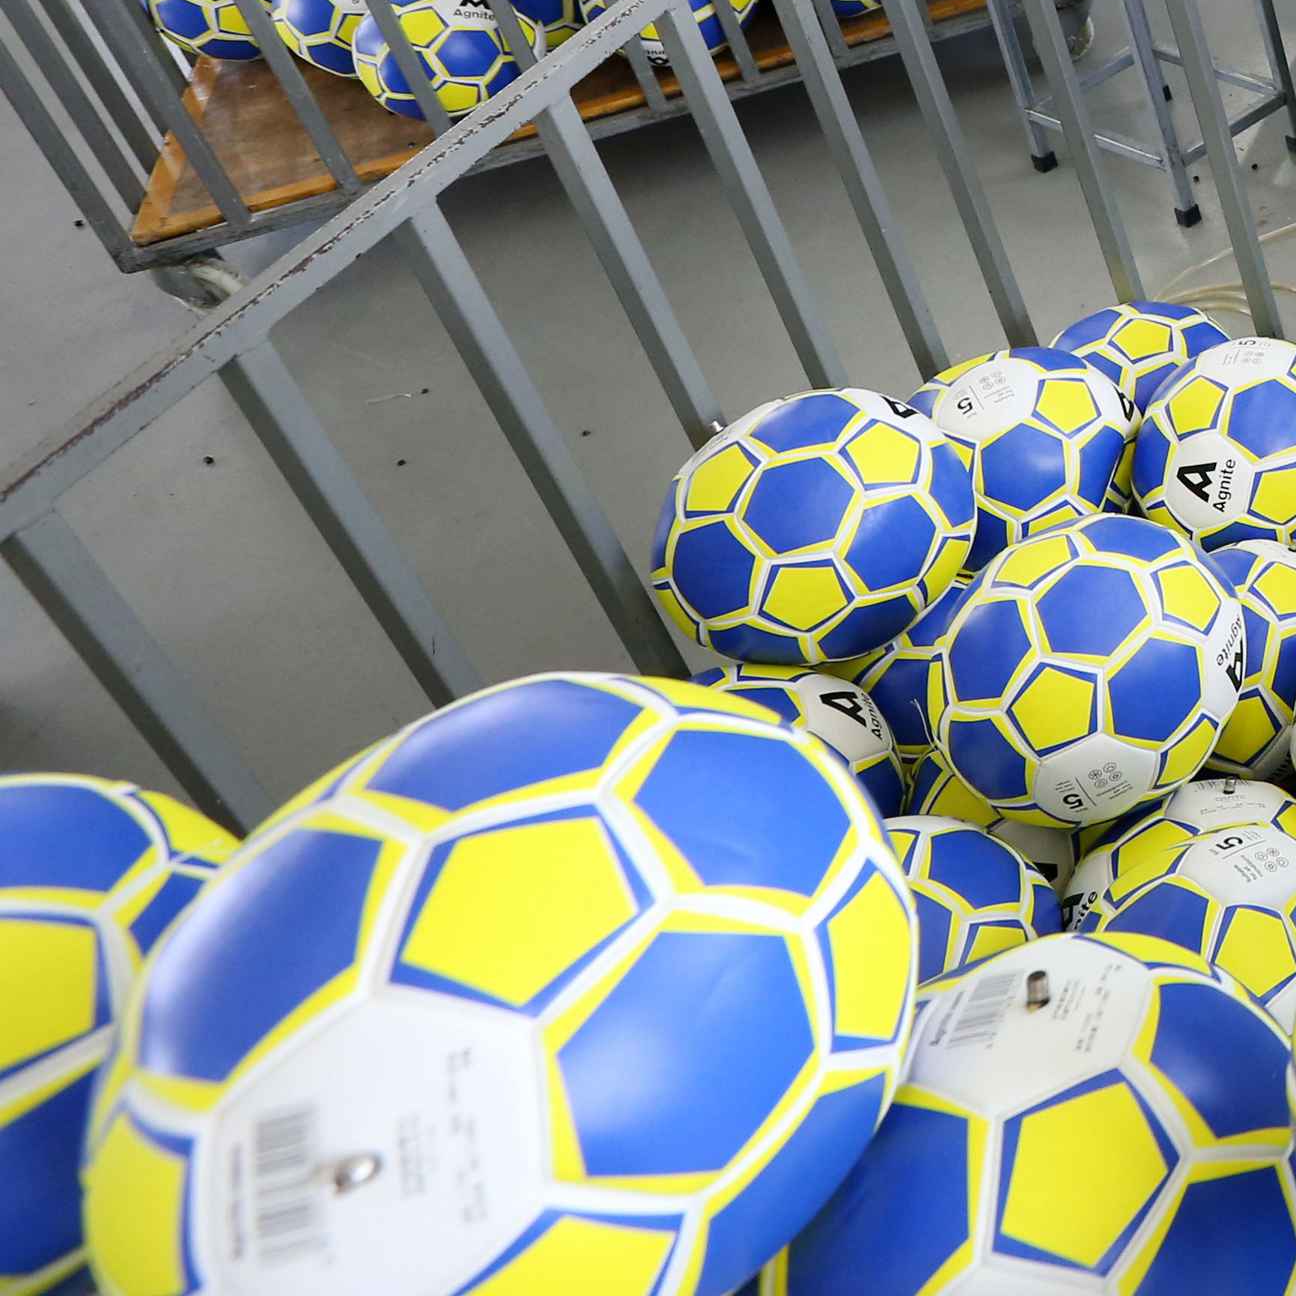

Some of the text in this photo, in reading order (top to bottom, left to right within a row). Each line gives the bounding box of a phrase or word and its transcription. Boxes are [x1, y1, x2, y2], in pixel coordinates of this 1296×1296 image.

[453, 8, 496, 21] Agnite
[956, 396, 974, 415] 5
[1213, 458, 1237, 514] Agnite
[1062, 793, 1084, 810] 5
[1215, 836, 1244, 850] 5
